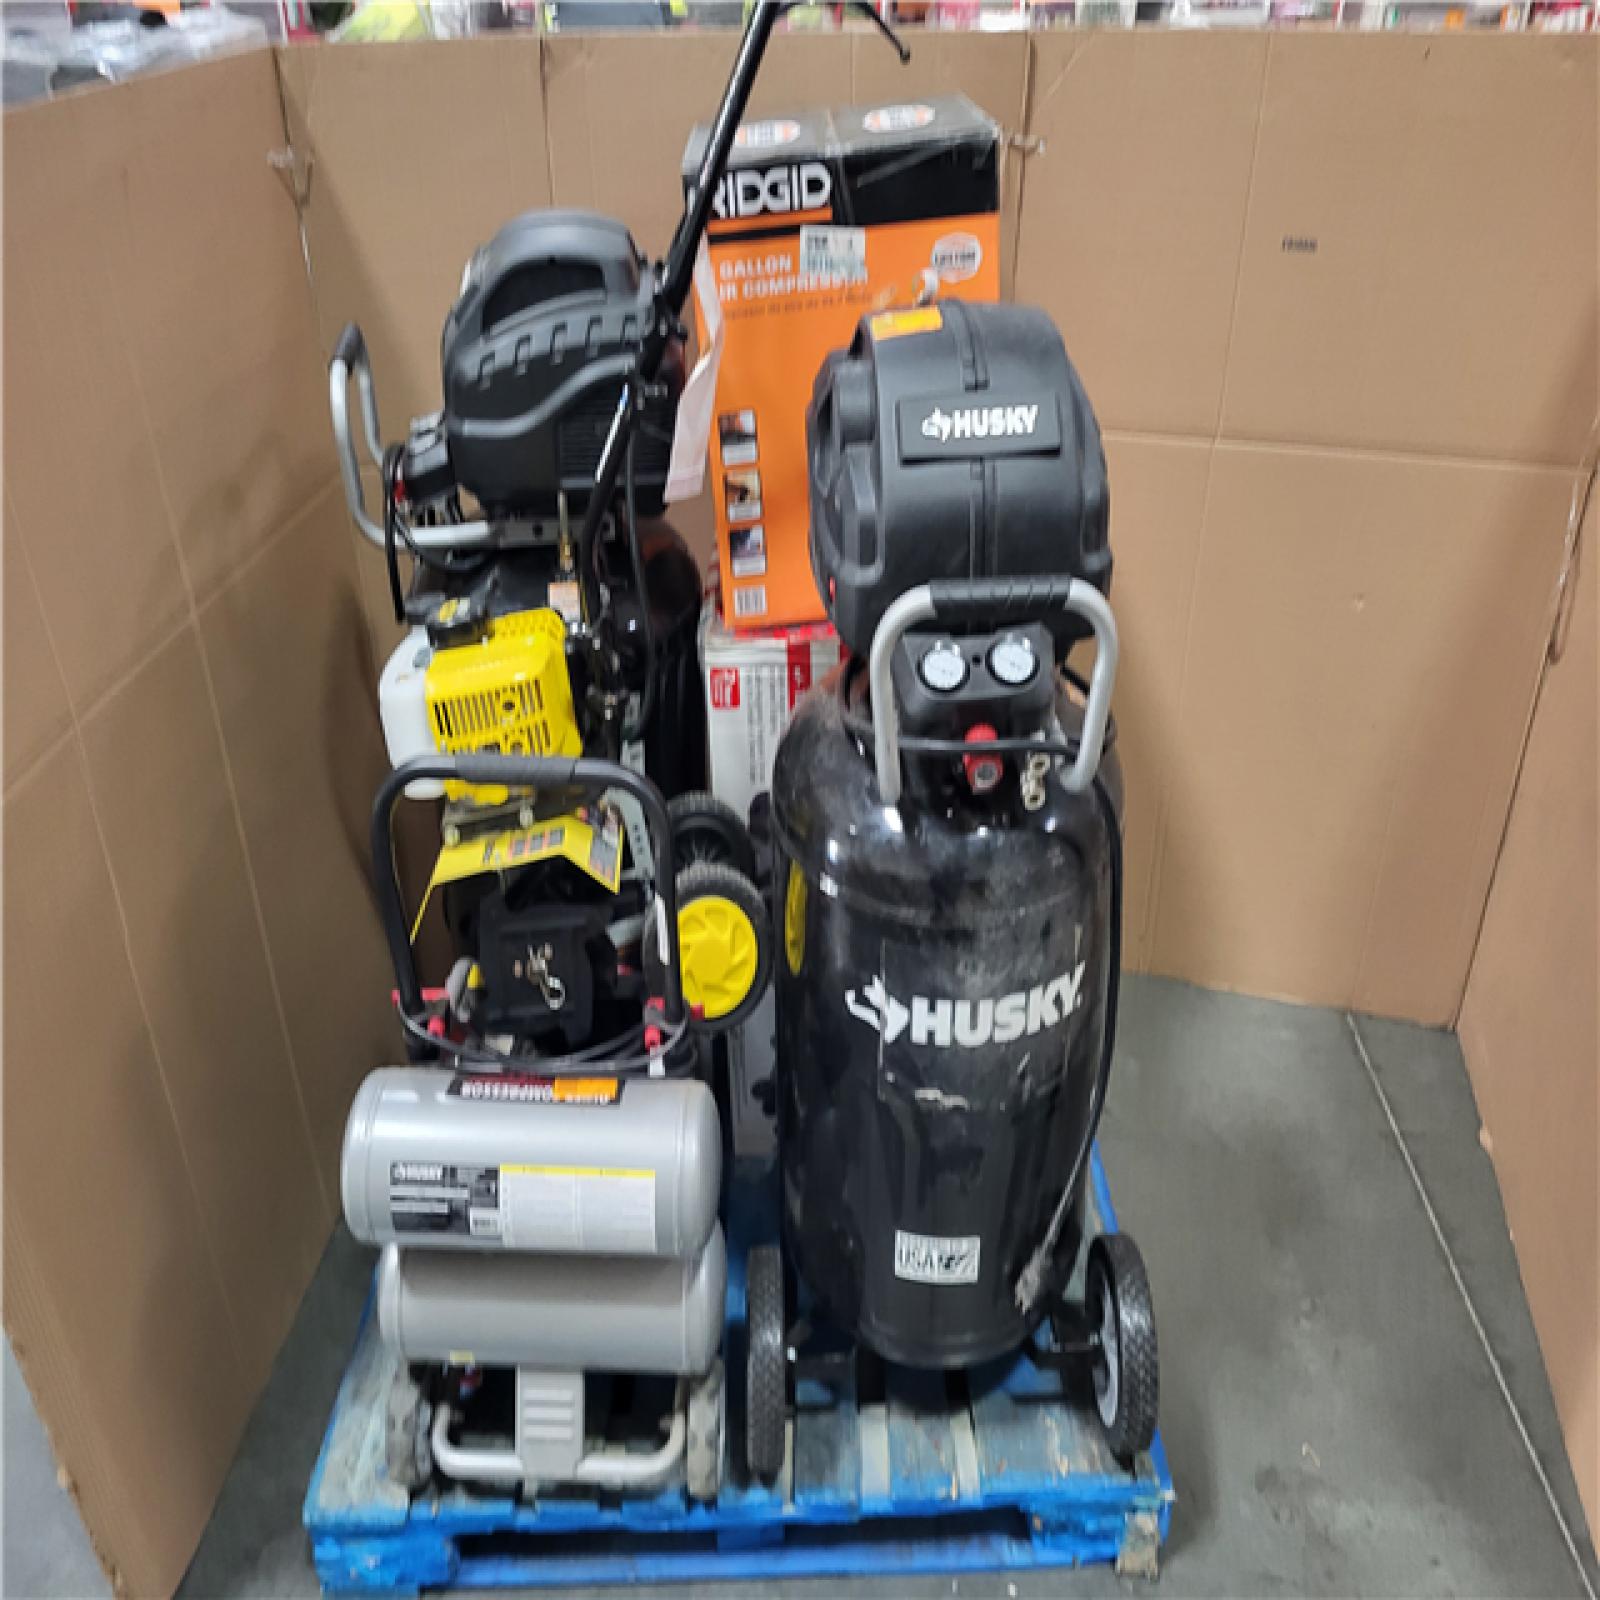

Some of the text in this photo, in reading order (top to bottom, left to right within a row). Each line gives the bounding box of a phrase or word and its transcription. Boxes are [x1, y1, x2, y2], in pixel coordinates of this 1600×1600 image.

[720, 254, 792, 280] GALLON
[954, 404, 1038, 438] HUSKY
[910, 960, 1086, 1047] HUSKY
